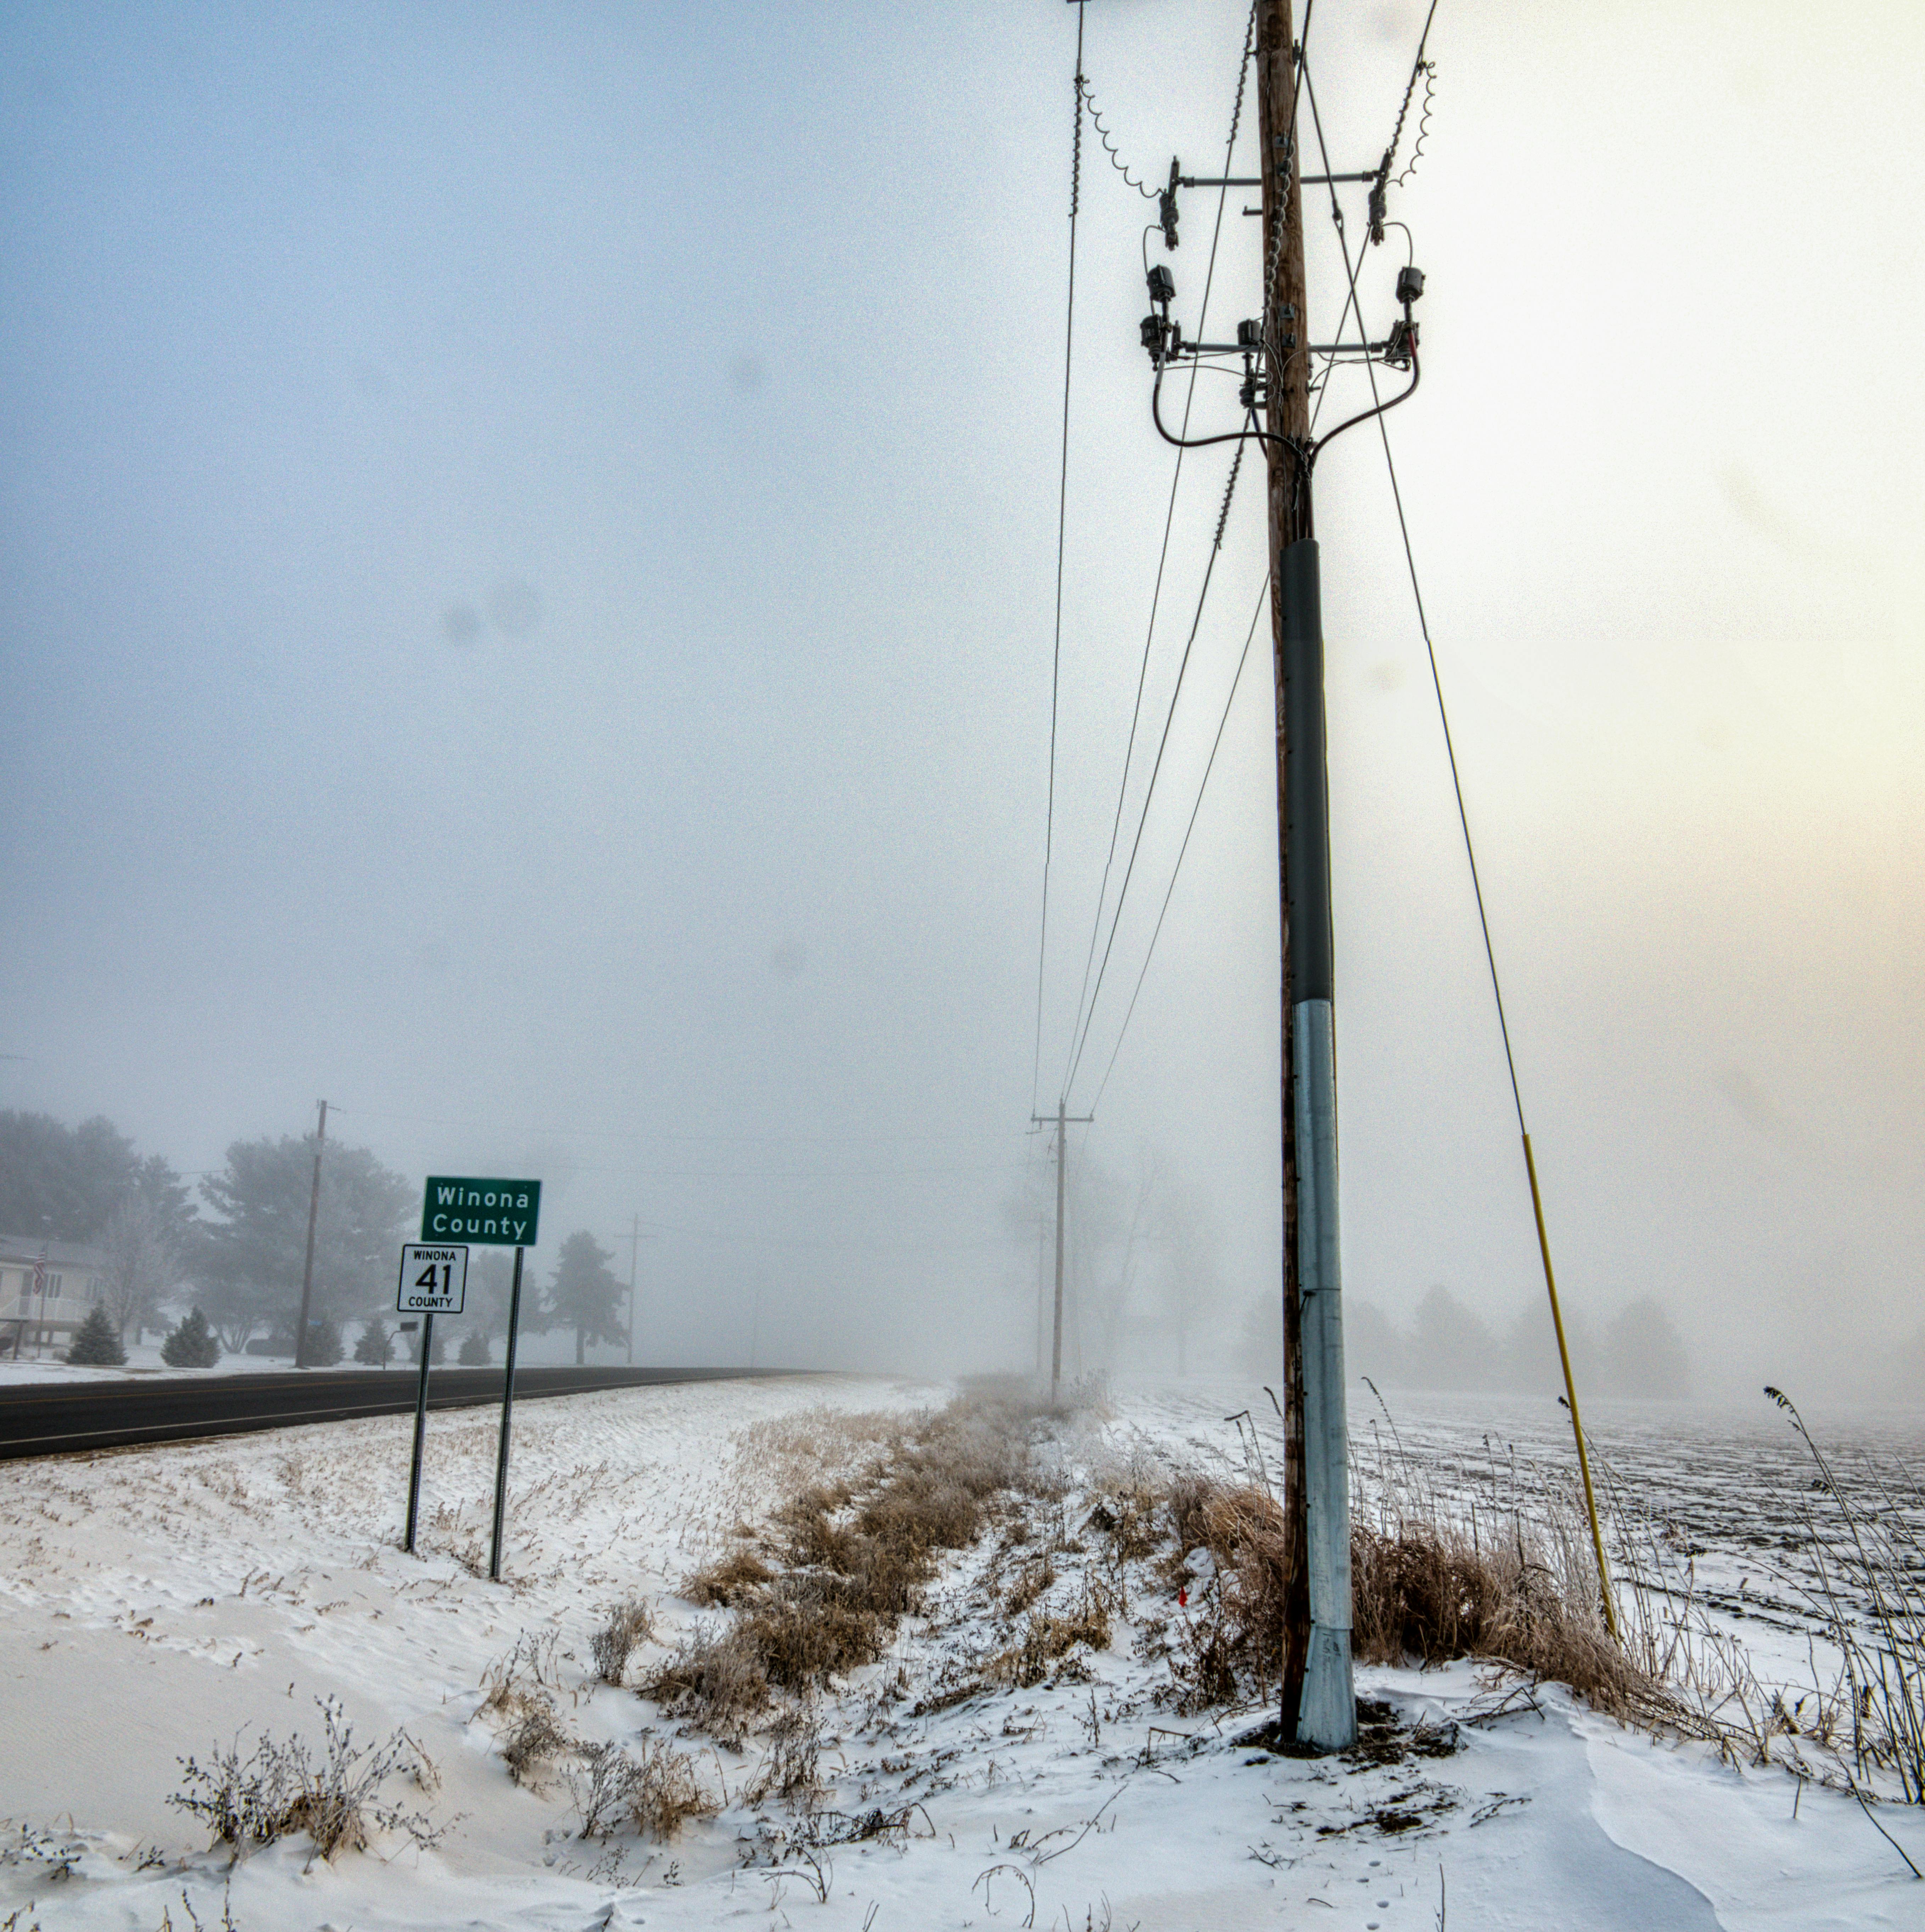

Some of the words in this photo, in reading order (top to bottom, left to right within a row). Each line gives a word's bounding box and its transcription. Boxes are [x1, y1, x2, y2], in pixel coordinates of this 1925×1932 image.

[437, 1186, 528, 1208] Winona
[433, 1213, 527, 1240] County
[414, 1250, 456, 1261] WINONA
[415, 1264, 451, 1294] 41
[409, 1296, 453, 1307] COUNTY
